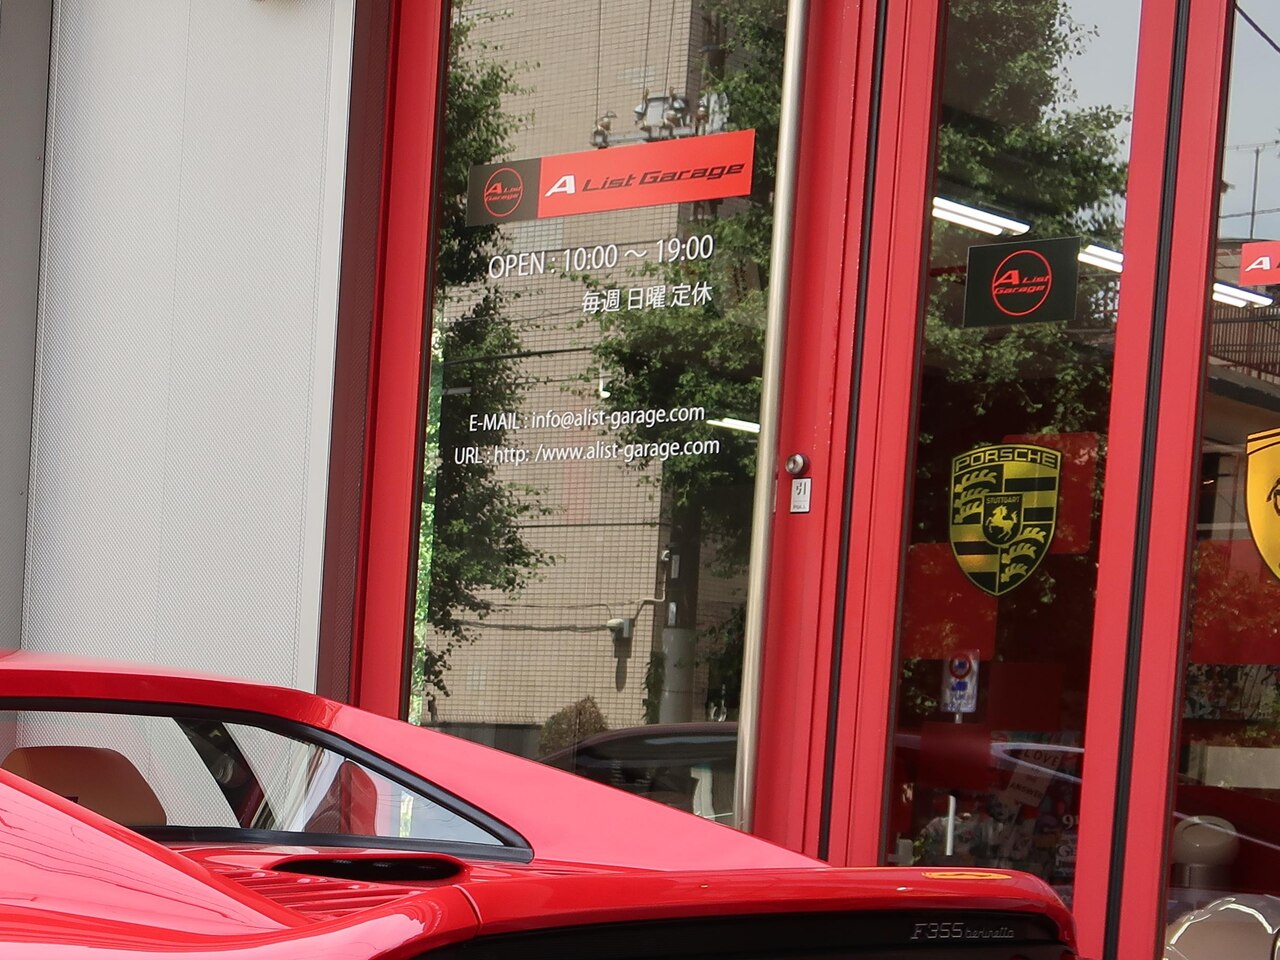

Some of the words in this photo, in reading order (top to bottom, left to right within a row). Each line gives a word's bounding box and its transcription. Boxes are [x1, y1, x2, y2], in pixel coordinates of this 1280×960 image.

[544, 175, 576, 197] A
[582, 174, 636, 193] List
[639, 163, 746, 186] Garage
[488, 251, 546, 279] OPEN
[563, 244, 618, 272] 10:00
[656, 234, 714, 263] 19:00
[993, 269, 1020, 286] A
[993, 285, 1046, 295] Garage
[469, 414, 520, 432] E-MAIL
[531, 406, 705, 430] info@alist-garage.com
[454, 447, 483, 465] URL
[955, 449, 1056, 472] PORSCHE
[910, 922, 965, 940] F355
